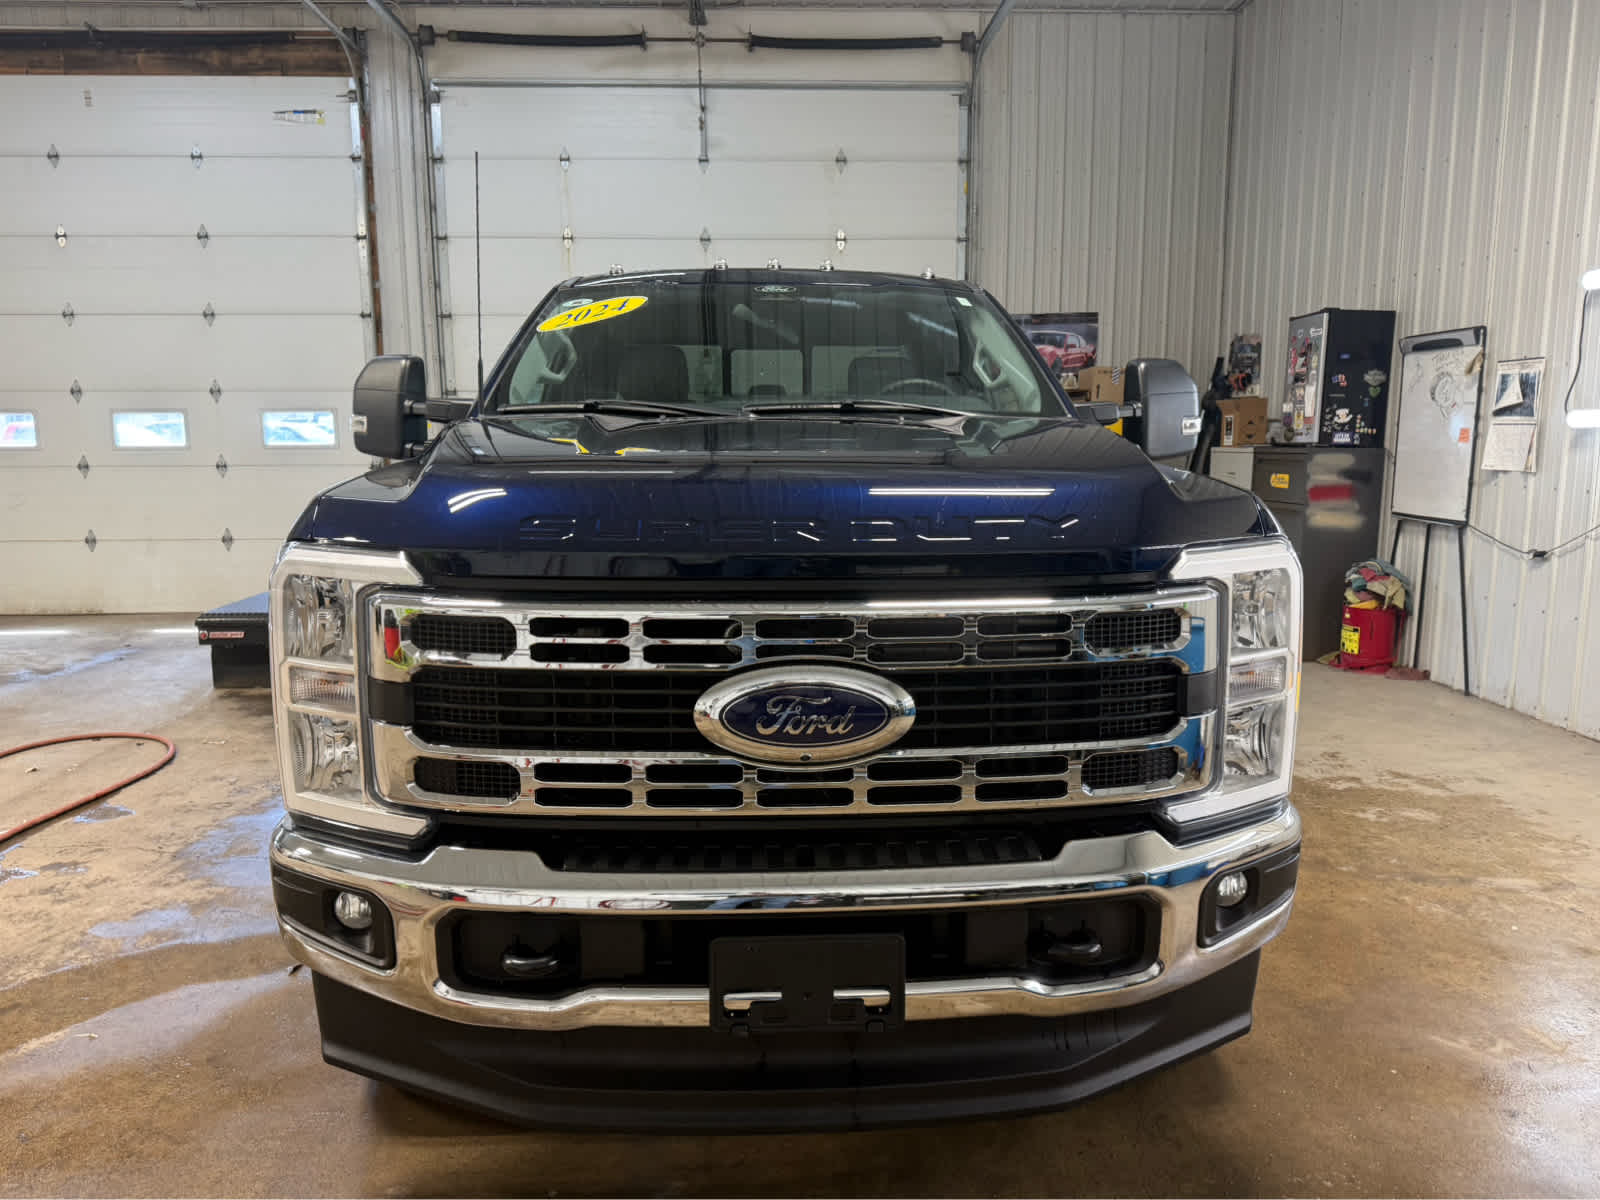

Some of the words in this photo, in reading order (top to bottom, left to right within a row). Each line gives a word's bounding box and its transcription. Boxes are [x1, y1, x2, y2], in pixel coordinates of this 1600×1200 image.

[553, 298, 631, 328] 2024
[848, 515, 1082, 543] DUTY
[755, 695, 855, 736] Ford
